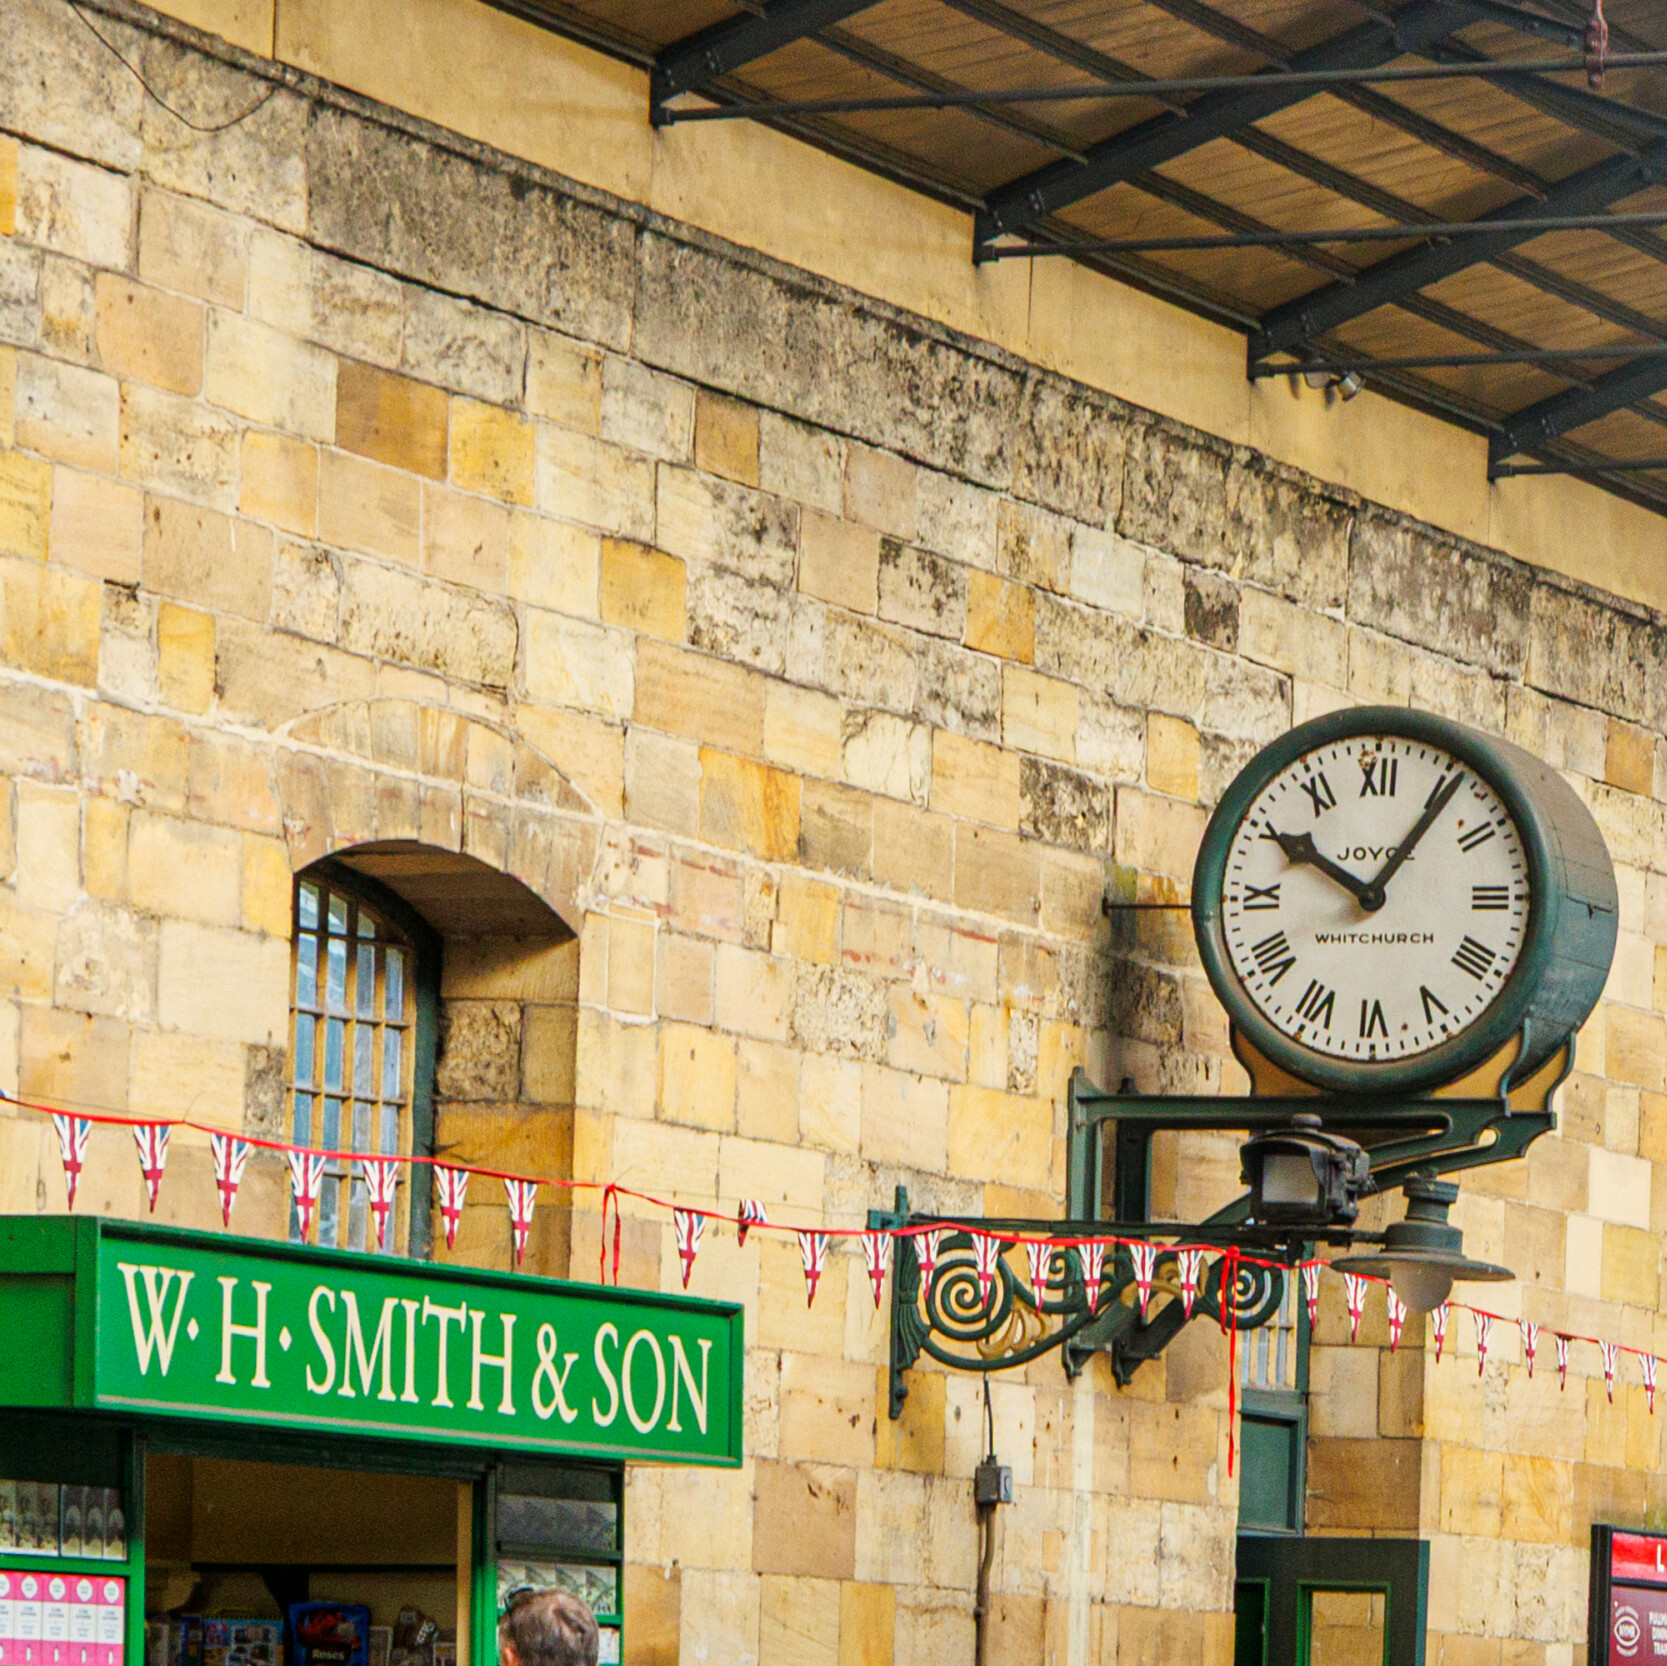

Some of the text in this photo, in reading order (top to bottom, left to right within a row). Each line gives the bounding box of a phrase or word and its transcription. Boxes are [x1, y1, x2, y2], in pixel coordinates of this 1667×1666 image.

[1471, 885, 1510, 911] III
[1314, 932, 1435, 946] WHITCHURCH
[304, 1285, 519, 1416] SMITH
[530, 1323, 580, 1425] &
[591, 1322, 714, 1436] SON
[311, 1649, 346, 1662] Roses
